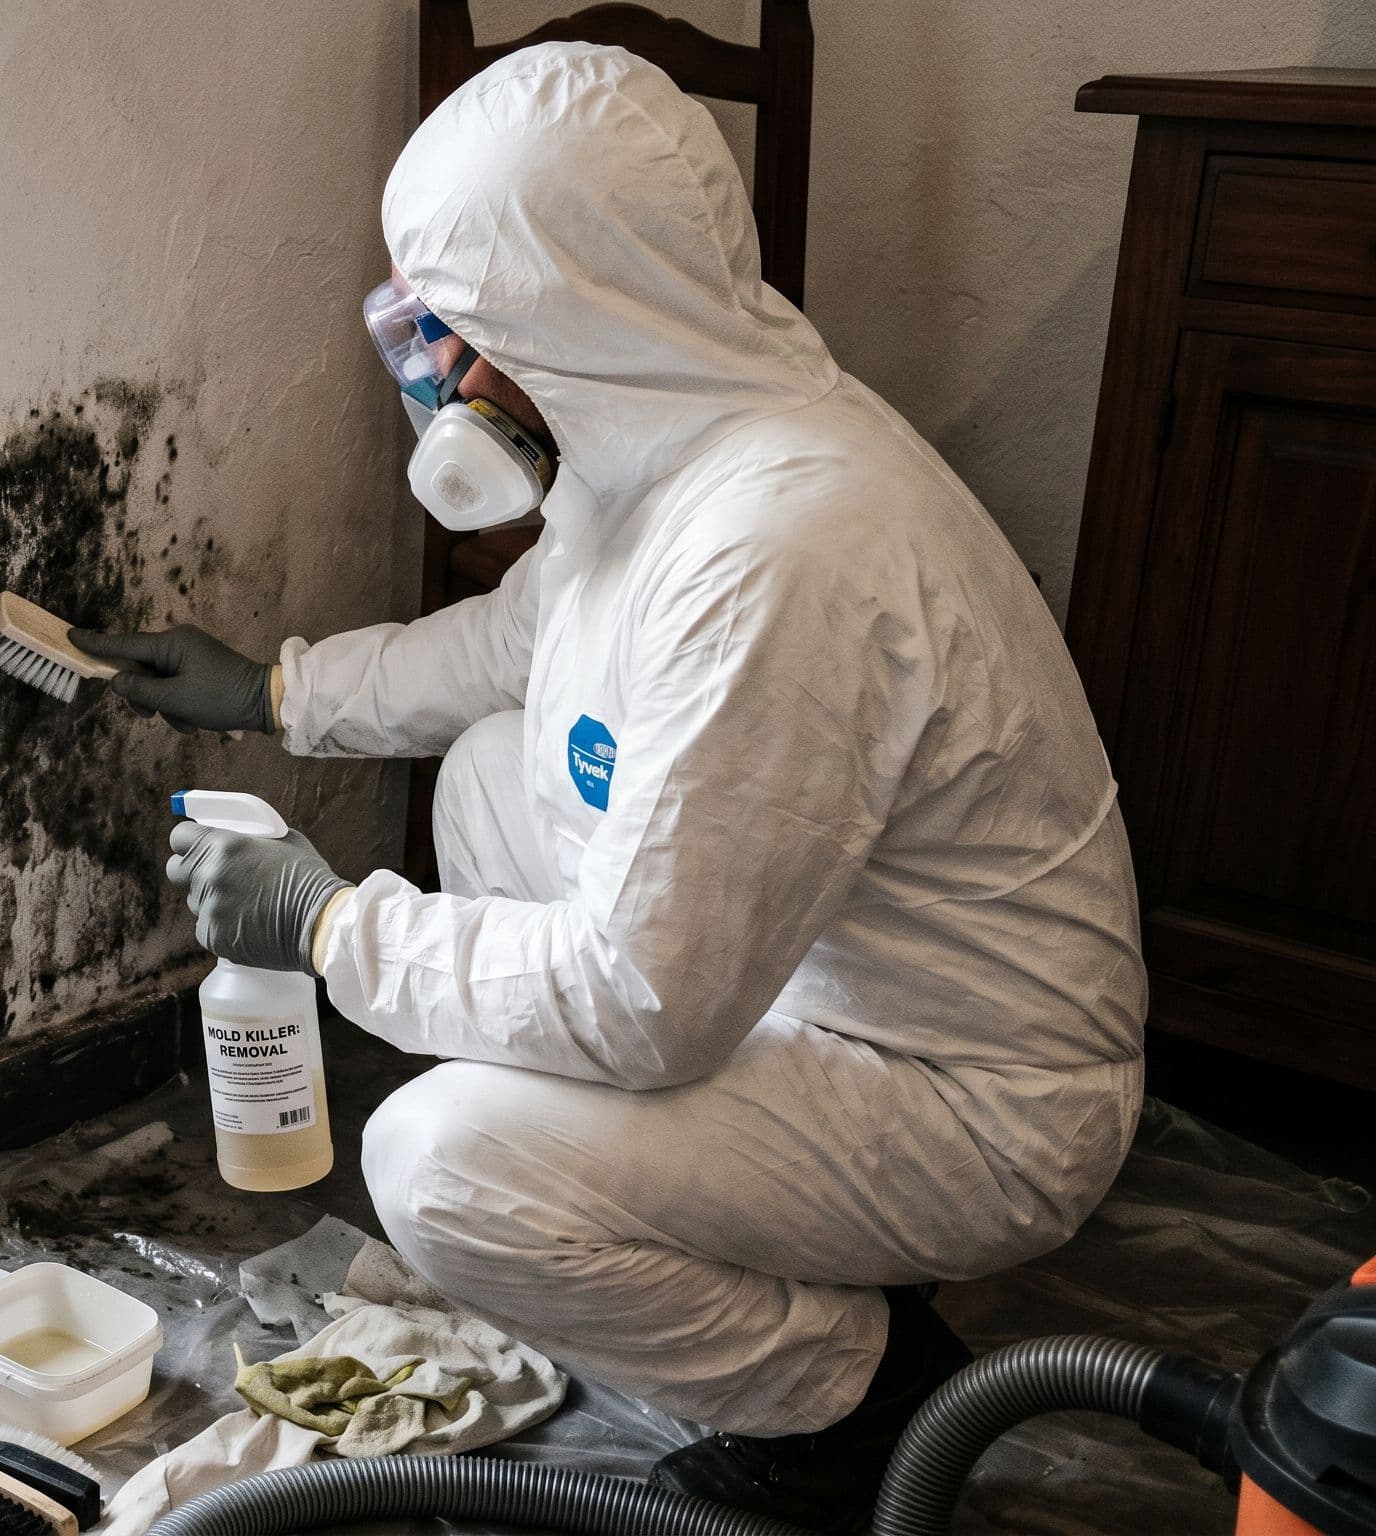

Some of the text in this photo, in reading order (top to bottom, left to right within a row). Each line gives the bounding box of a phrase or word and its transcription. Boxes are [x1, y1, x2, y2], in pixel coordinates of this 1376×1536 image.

[573, 751, 609, 781] Tyvek
[208, 1024, 300, 1042] MOLD KILLER:
[219, 1043, 288, 1058] REMOVAL
